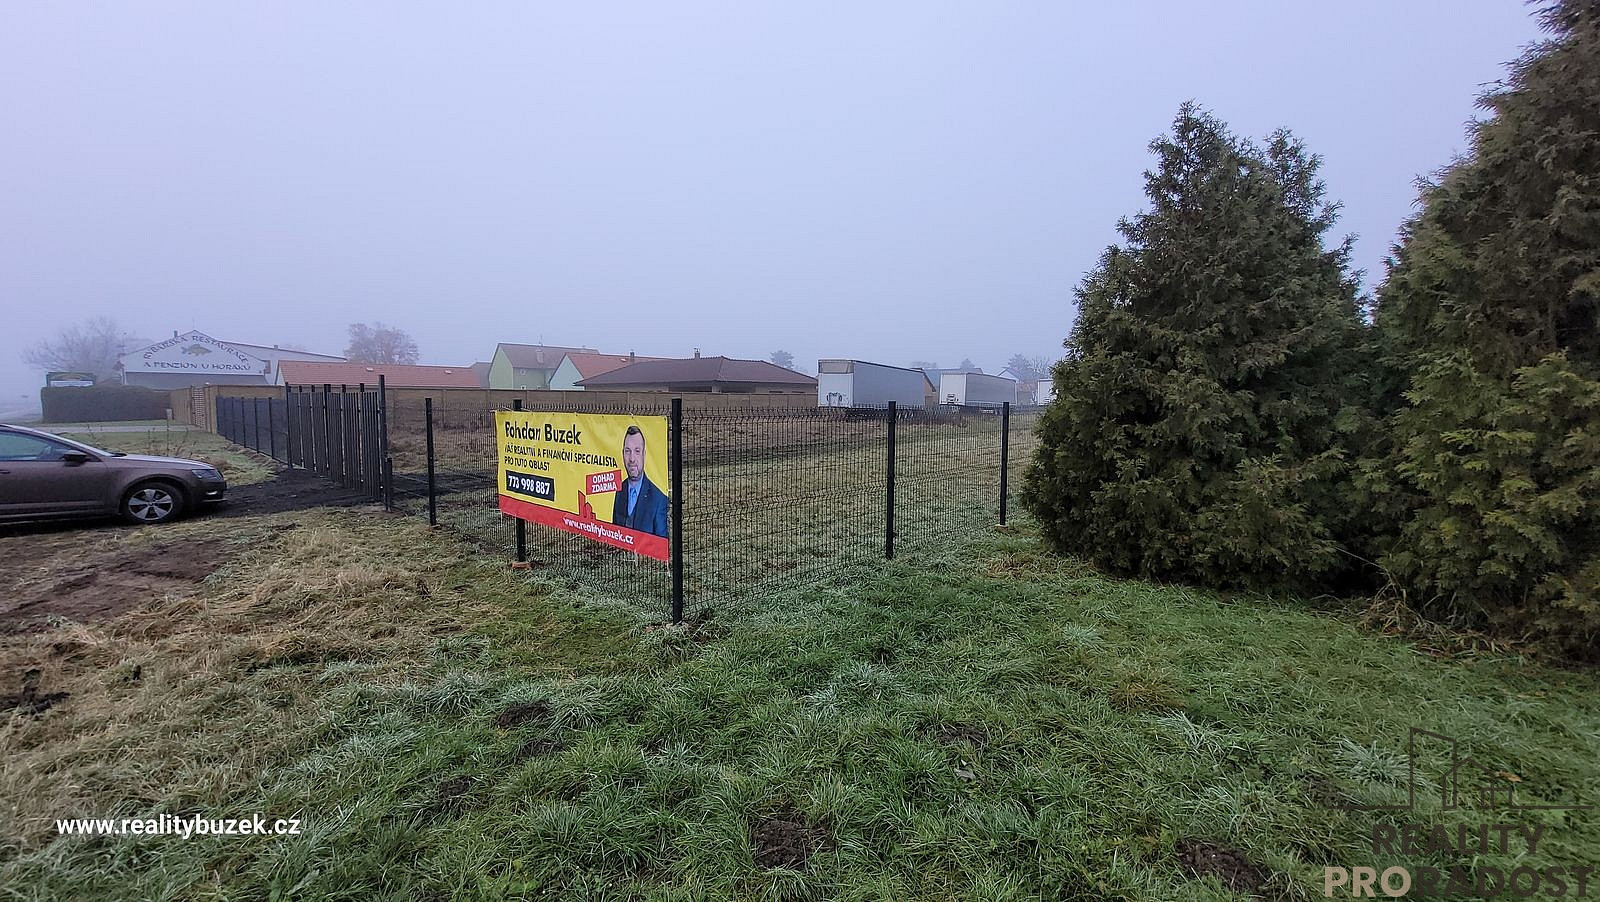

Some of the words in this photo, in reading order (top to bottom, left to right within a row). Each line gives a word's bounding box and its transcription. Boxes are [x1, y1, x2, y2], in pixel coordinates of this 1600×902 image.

[544, 423, 582, 445] Buzek
[504, 456, 514, 466] PRO
[514, 458, 528, 468] TUTO
[528, 460, 550, 471] OBLAST
[537, 448, 542, 458] A
[542, 448, 573, 462] FINANČNÍ
[574, 452, 618, 468] SPECIALISTA
[508, 475, 520, 489] 773
[520, 477, 535, 492] 998
[535, 480, 551, 495] 887
[591, 482, 617, 493] ZDARMA
[592, 472, 615, 484] ODHAD
[563, 518, 634, 545] www.realitybuzek.cz
